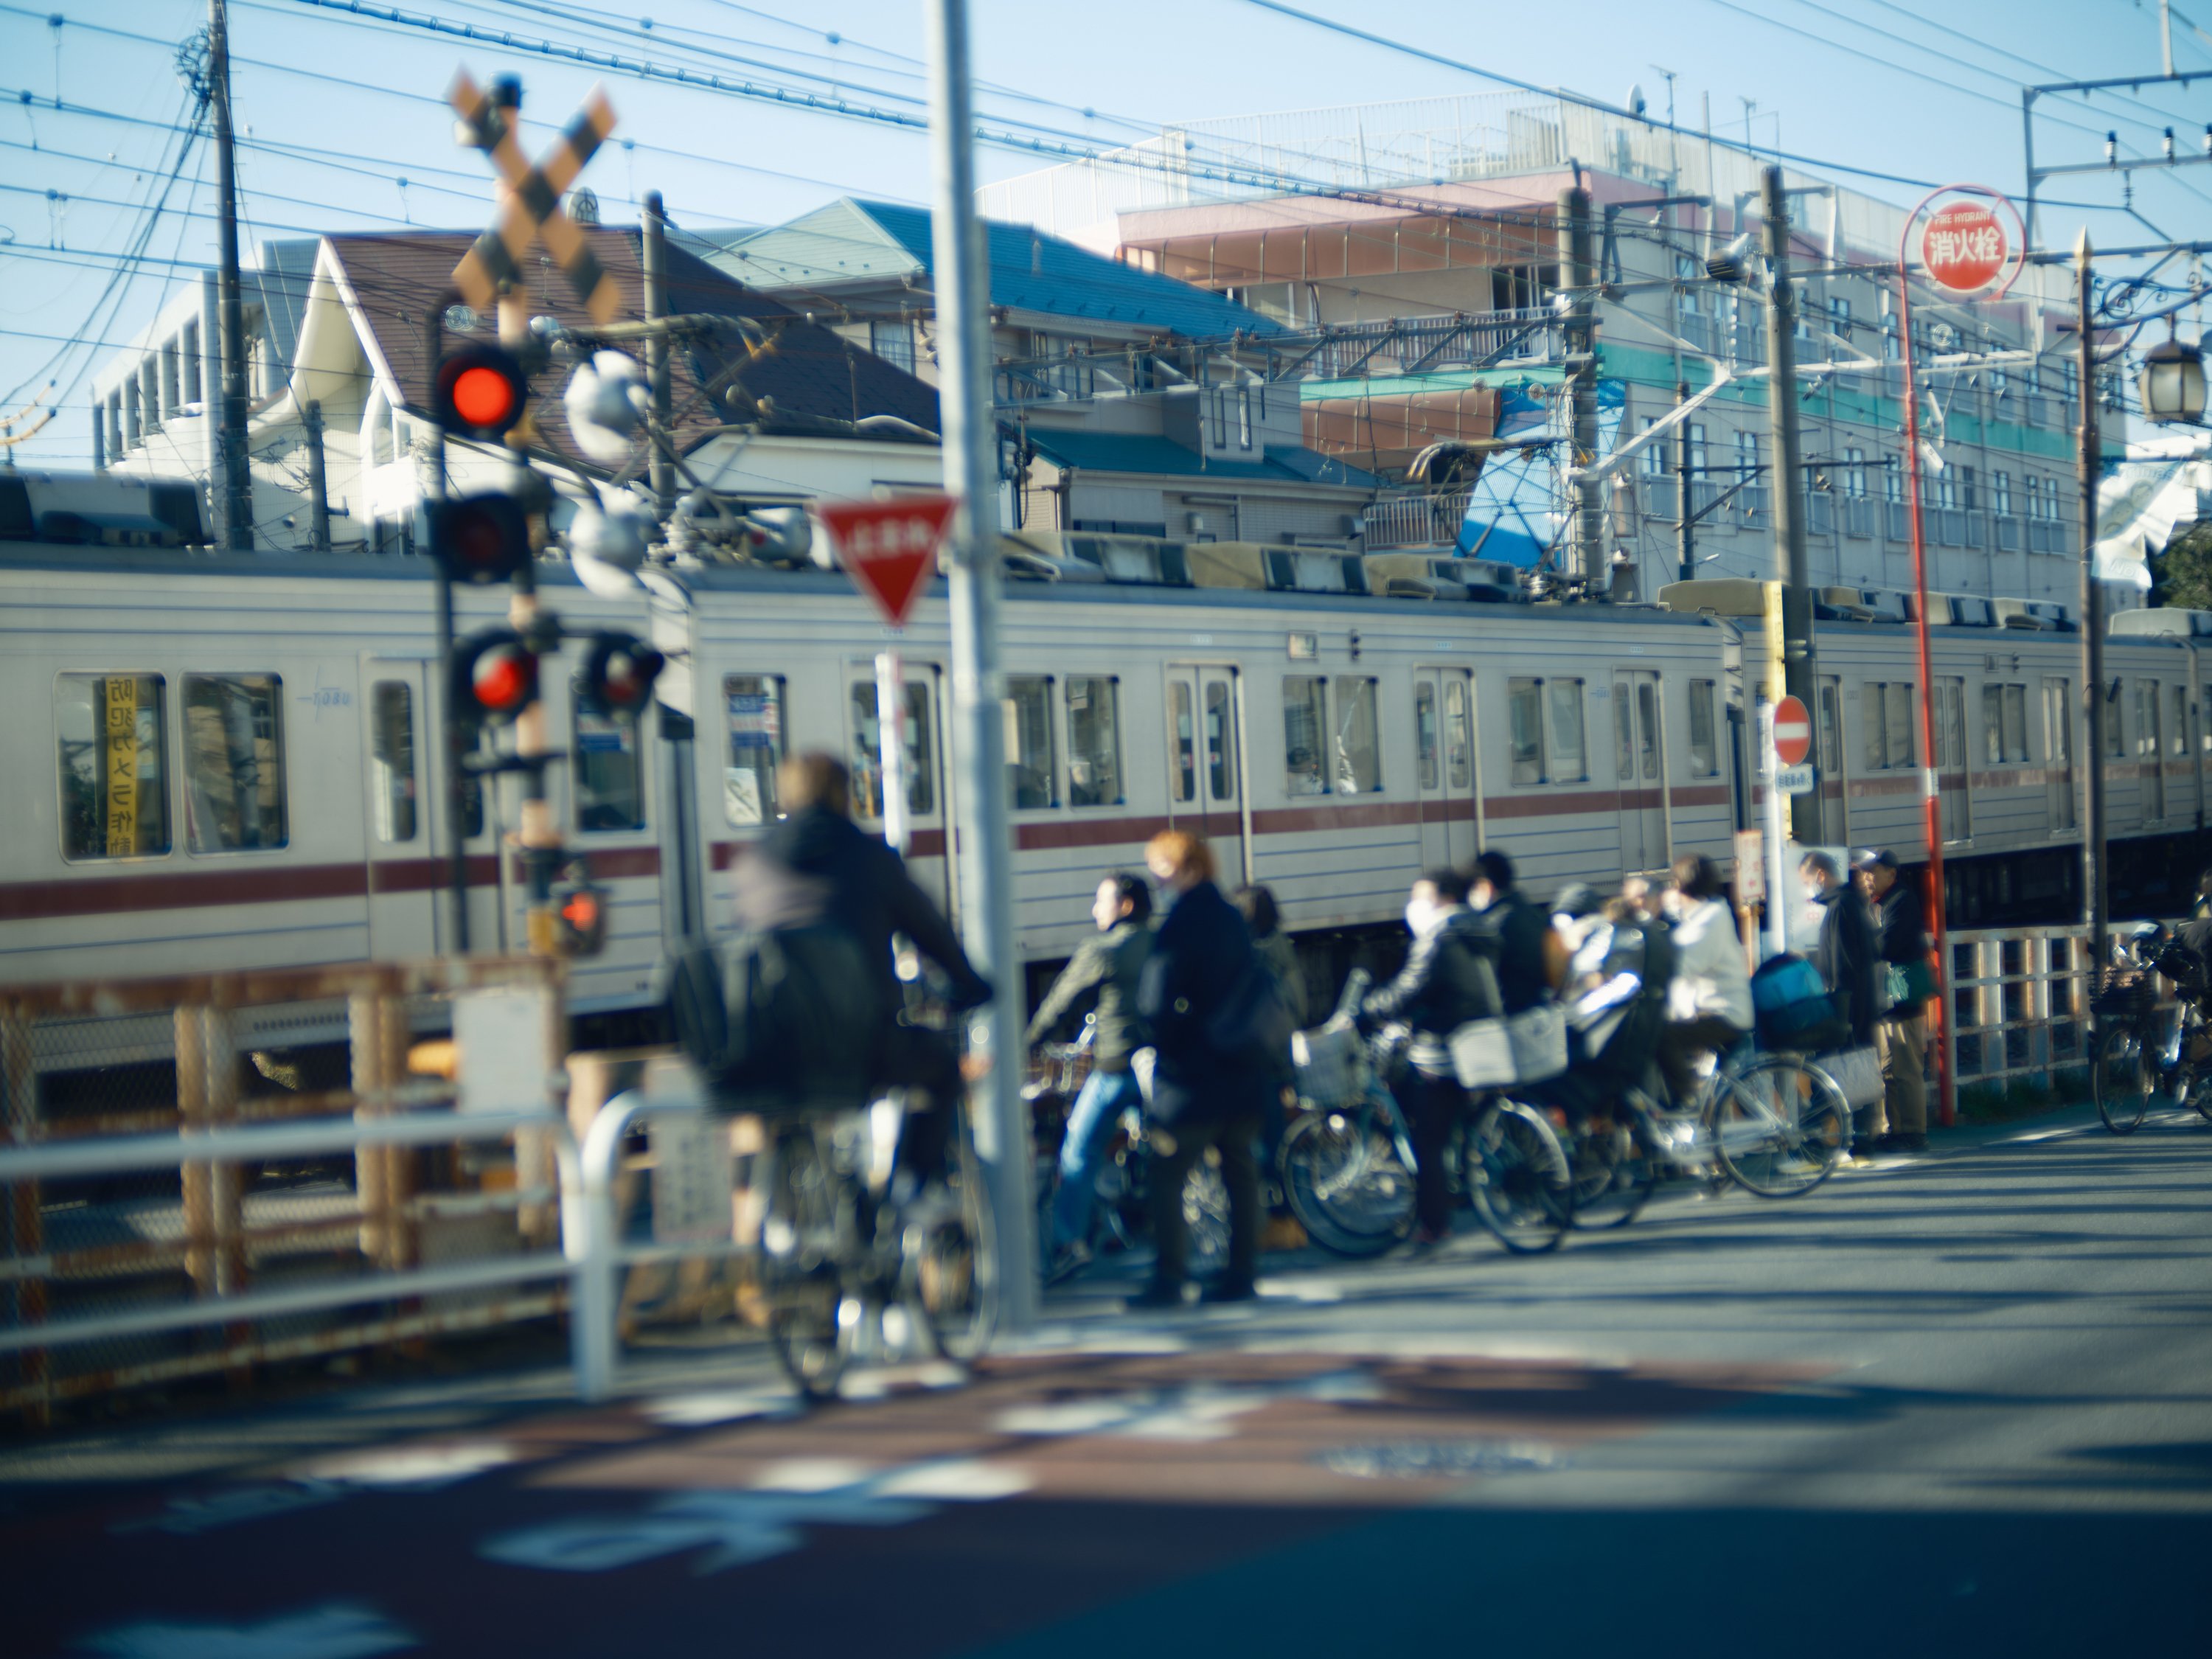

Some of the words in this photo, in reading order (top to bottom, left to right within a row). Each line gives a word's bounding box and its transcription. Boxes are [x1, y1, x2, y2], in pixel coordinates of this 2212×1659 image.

[1935, 214, 1952, 225] FIRE
[1955, 212, 1990, 223] HYDRANT
[1929, 226, 2001, 266] 消火栓
